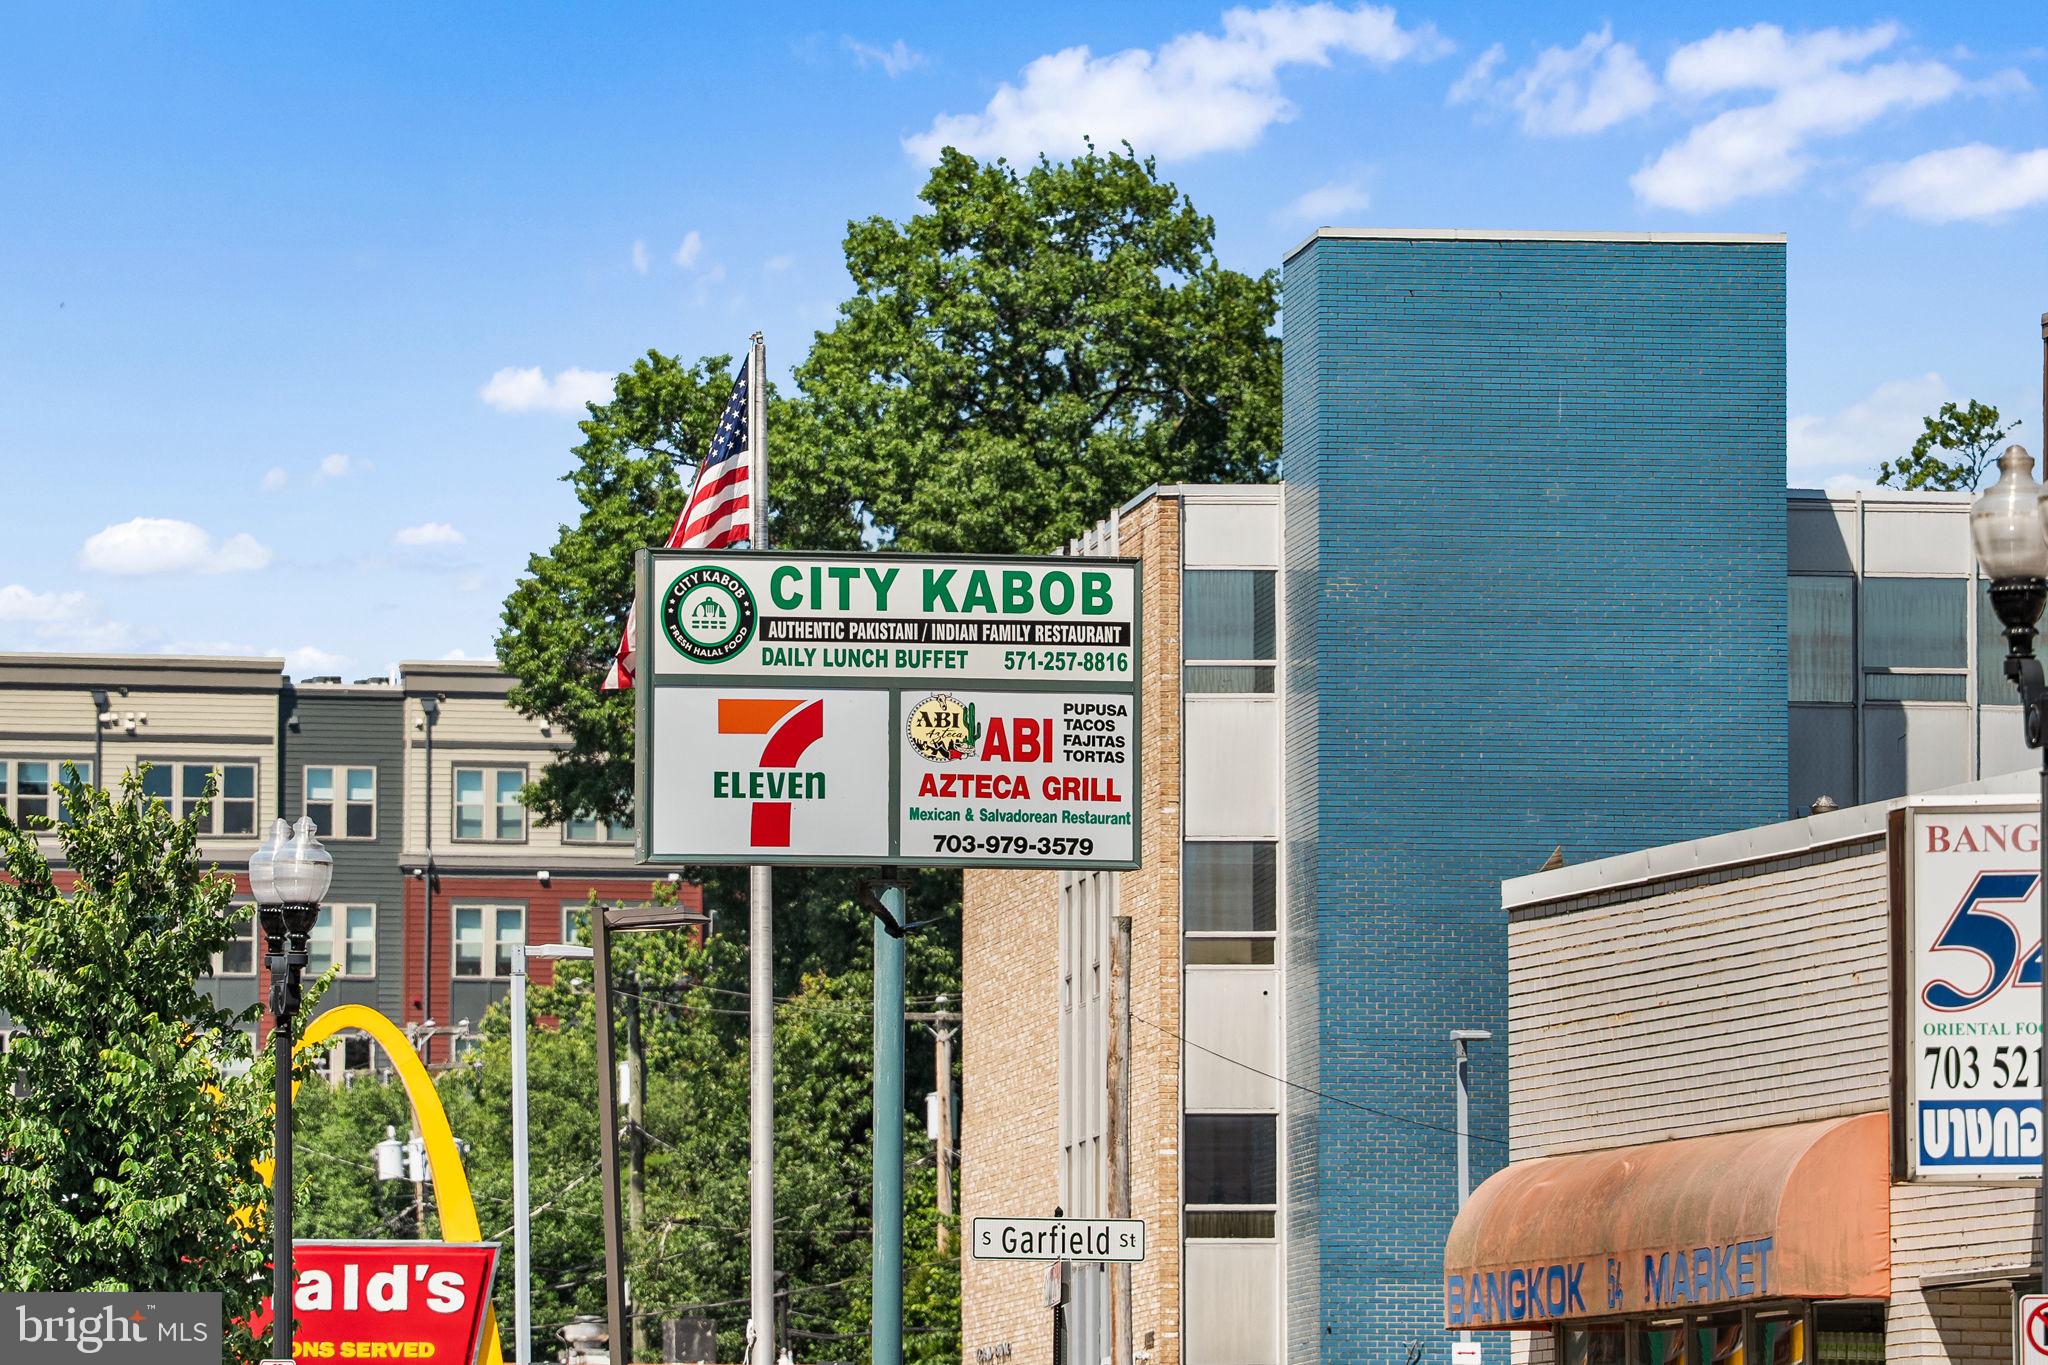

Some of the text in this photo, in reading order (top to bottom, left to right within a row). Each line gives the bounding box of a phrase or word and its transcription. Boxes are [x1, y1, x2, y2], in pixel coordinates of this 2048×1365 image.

[673, 570, 746, 599] CITY KABOB
[769, 565, 1114, 615] CITY KABOB
[669, 624, 748, 657] FRESH HALAL FOOD
[768, 620, 845, 639] AUTHENTIC
[850, 622, 918, 641] PAKISTANI
[931, 623, 978, 642] INDIAN
[982, 624, 1031, 643] FAMILY
[1035, 625, 1122, 644] RESTAURANT
[762, 647, 969, 669] DAILY LUNCH BUFFET
[1004, 651, 1128, 672] 571-257-8816
[916, 710, 961, 729] ABI
[1063, 703, 1128, 717] PUPUSA
[1063, 718, 1116, 732] TACOS
[980, 716, 1053, 763] ABI
[1063, 734, 1126, 748] FAJITAS
[1063, 750, 1125, 764] TORTAS
[718, 699, 824, 848] 7
[918, 773, 1122, 802] AZTECA GRILL
[909, 807, 1132, 825] Mexican & Salvadorean Restaurant
[933, 834, 1094, 856] 703-979-3579
[1925, 823, 2039, 853] BANG
[1923, 1022, 2012, 1036] ORIENTAL
[1923, 1045, 2043, 1090] 703 521
[982, 1224, 1137, 1256] S Garfield St
[272, 1264, 466, 1314] ald's
[1447, 1262, 1586, 1325] BANGKOK
[1644, 1236, 1774, 1307] MARKET
[340, 1341, 436, 1359] SERVED
